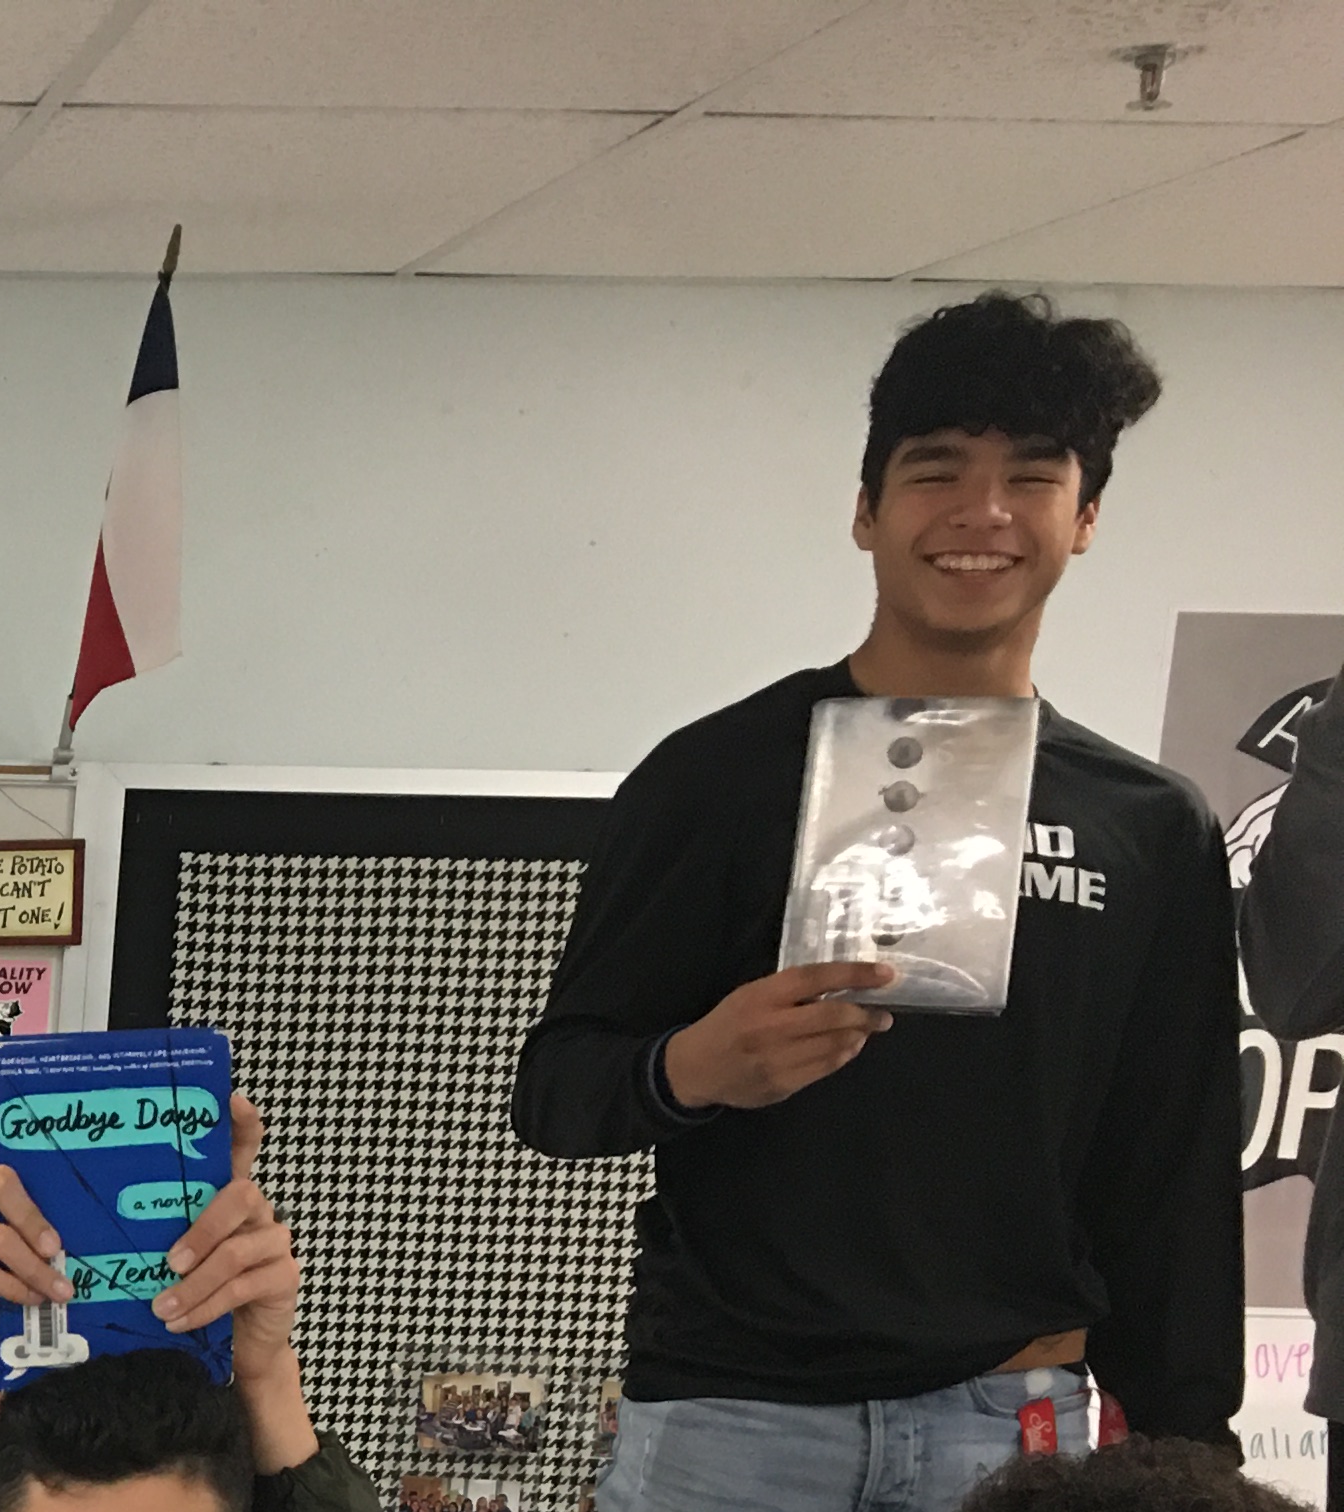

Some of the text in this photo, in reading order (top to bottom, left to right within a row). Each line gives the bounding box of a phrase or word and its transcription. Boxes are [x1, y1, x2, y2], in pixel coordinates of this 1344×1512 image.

[10, 855, 65, 876] POTATO
[0, 879, 50, 899] CAN'T
[0, 1097, 221, 1141] Goodbye Days
[133, 1188, 205, 1211] a novel
[72, 1267, 102, 1300] ff
